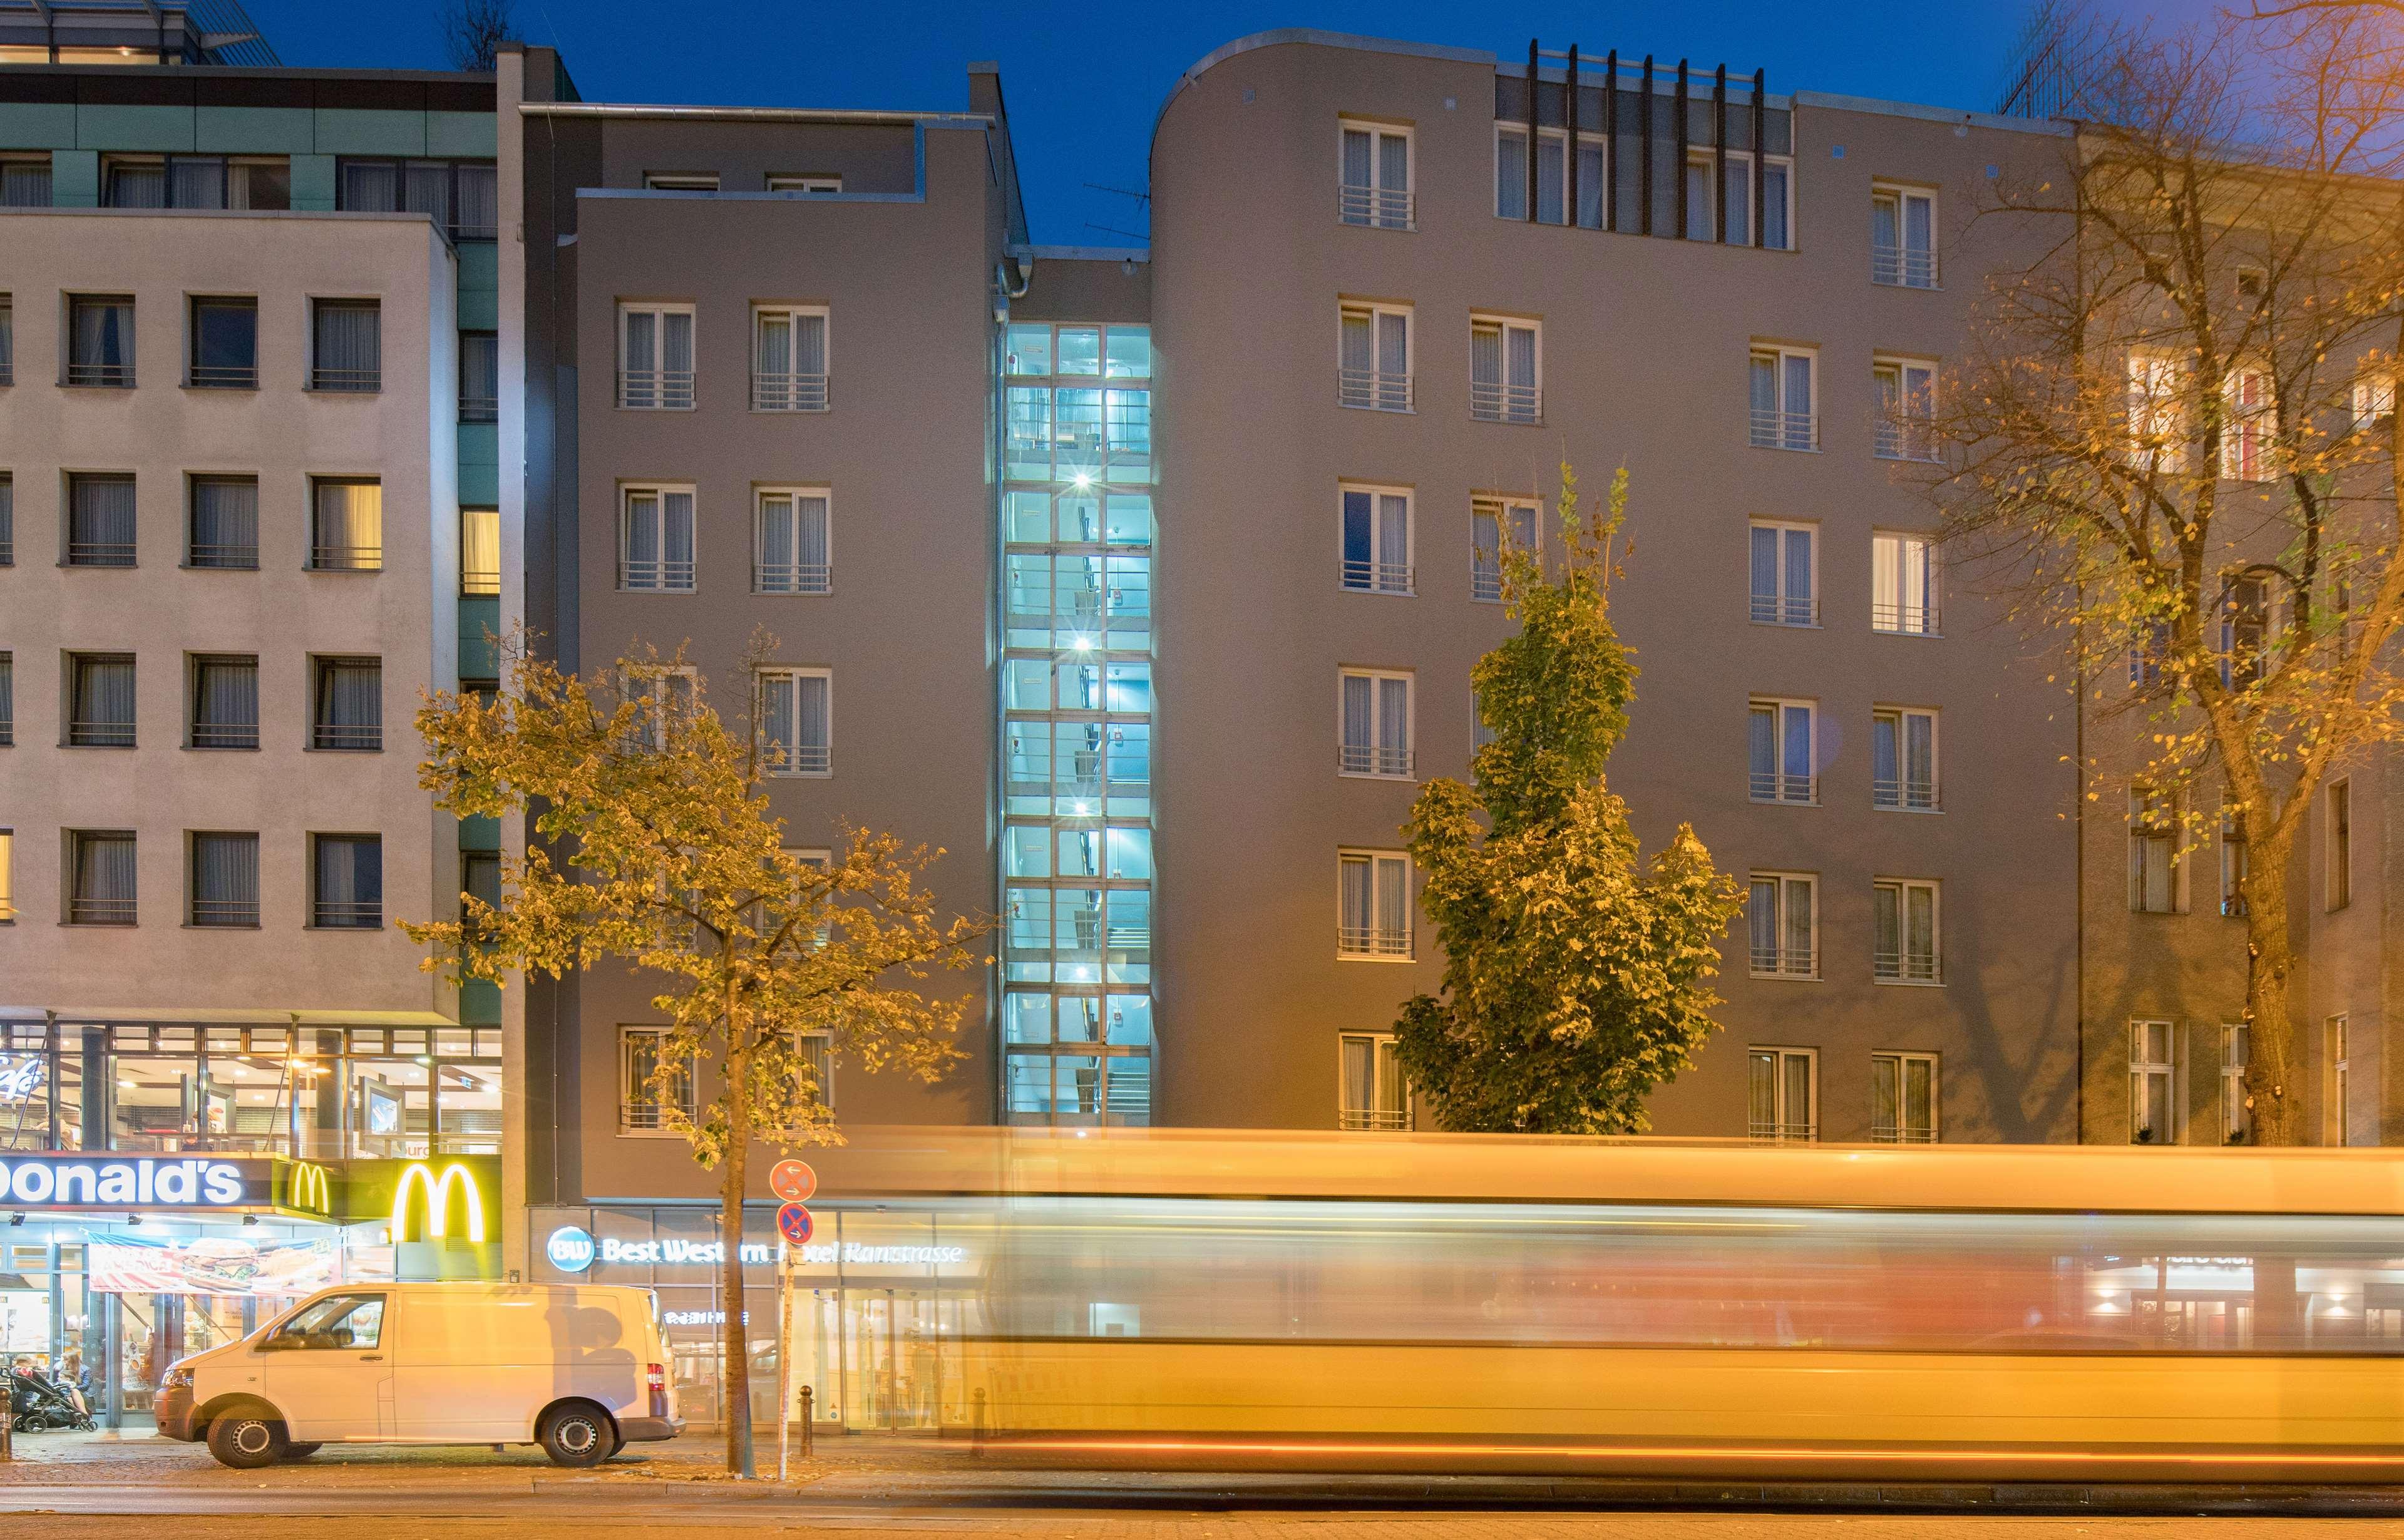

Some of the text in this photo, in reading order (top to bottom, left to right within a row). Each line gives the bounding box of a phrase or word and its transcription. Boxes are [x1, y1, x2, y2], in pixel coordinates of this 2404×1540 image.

[0, 1159, 242, 1203] onald's
[553, 1240, 591, 1260] BW
[603, 1239, 660, 1261] Best
[663, 1240, 769, 1262] Westrn
